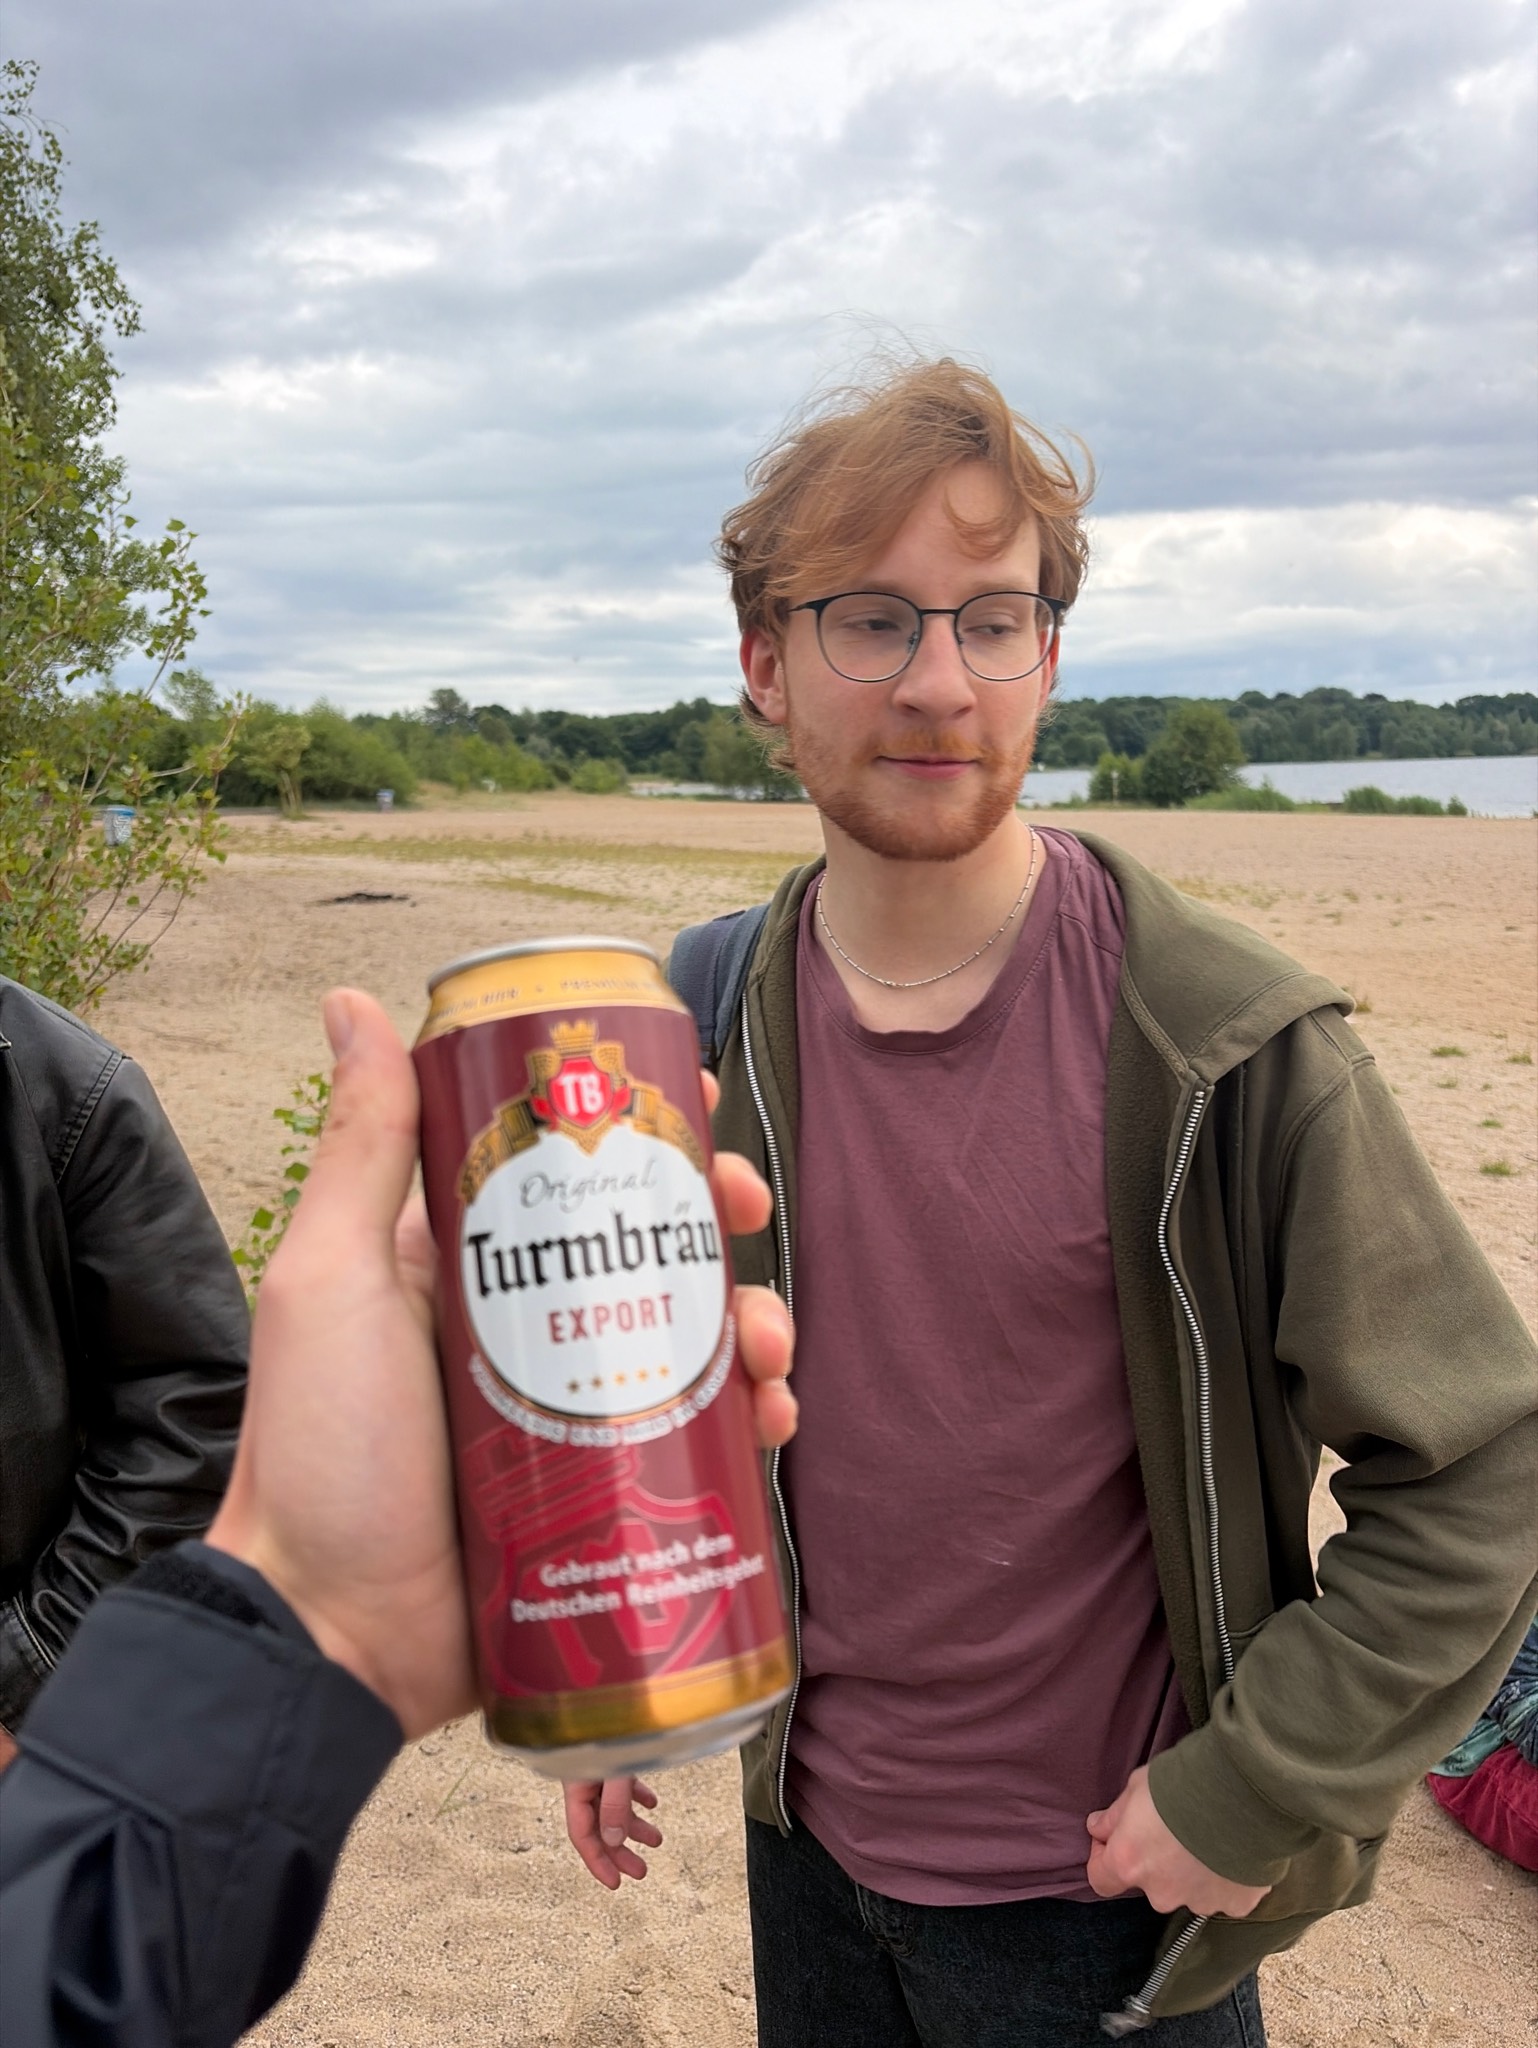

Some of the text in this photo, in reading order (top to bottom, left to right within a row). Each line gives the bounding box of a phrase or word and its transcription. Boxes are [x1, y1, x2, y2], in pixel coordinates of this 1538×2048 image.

[558, 1072, 605, 1116] TB
[520, 1158, 657, 1213] Original
[467, 1202, 721, 1298] Turmbräu
[548, 1294, 674, 1344] EXPORT
[540, 1555, 633, 1588] Gebraut
[635, 1540, 691, 1571] nach
[511, 1590, 622, 1623] Deutschen
